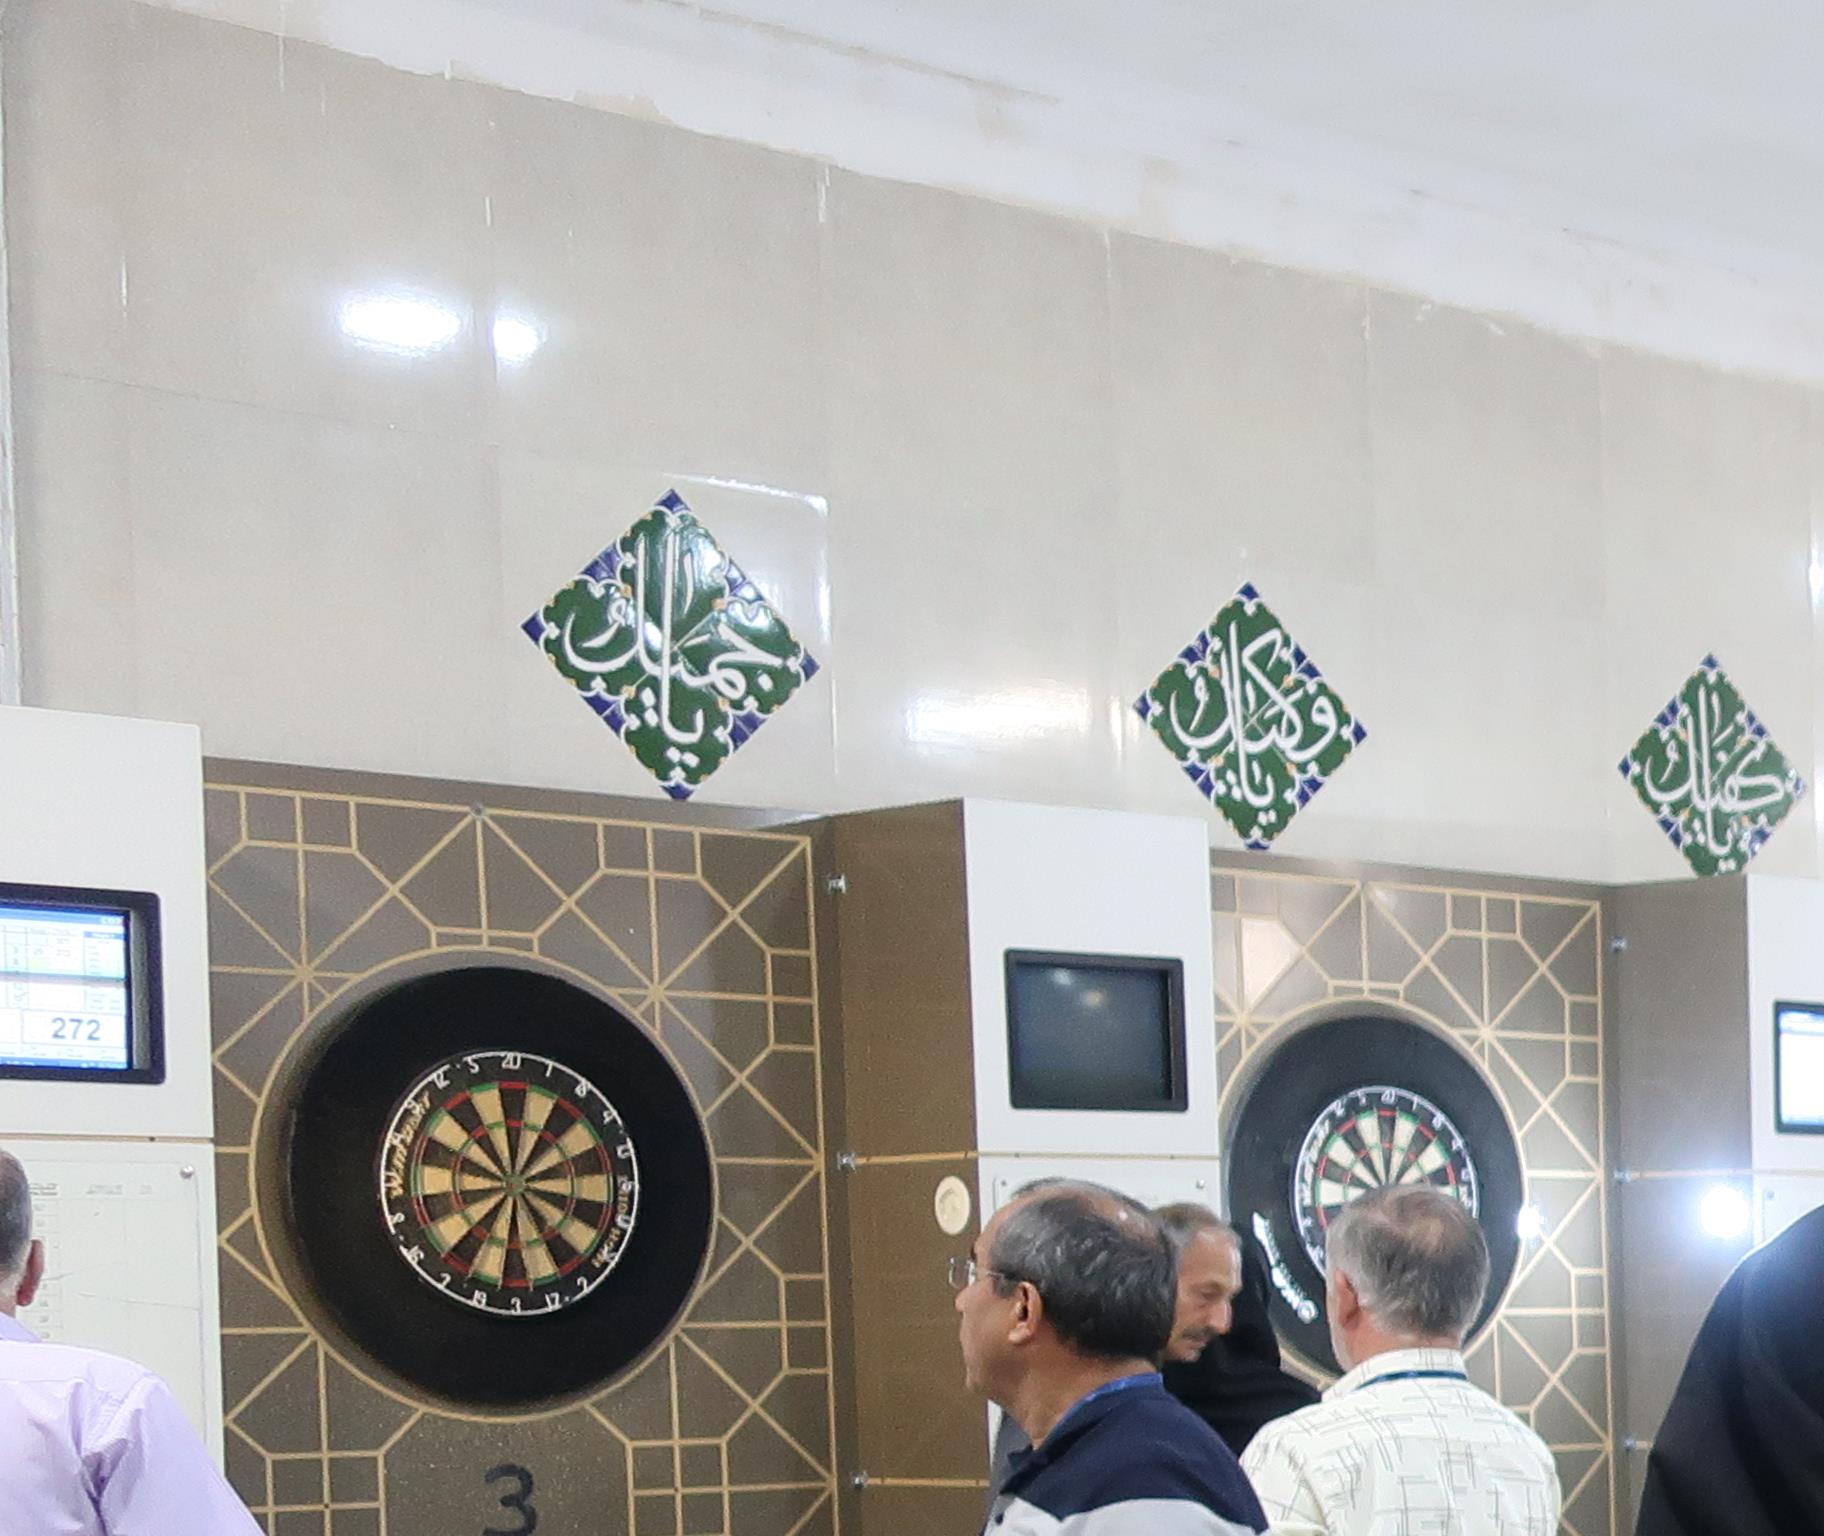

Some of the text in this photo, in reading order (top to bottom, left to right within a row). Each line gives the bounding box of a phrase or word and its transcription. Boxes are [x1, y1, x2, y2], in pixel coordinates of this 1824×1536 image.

[51, 1017, 101, 1042] 272
[465, 1056, 480, 1075] 5
[501, 1052, 522, 1071] 20
[576, 1276, 591, 1293] 2
[510, 1296, 522, 1314] 3
